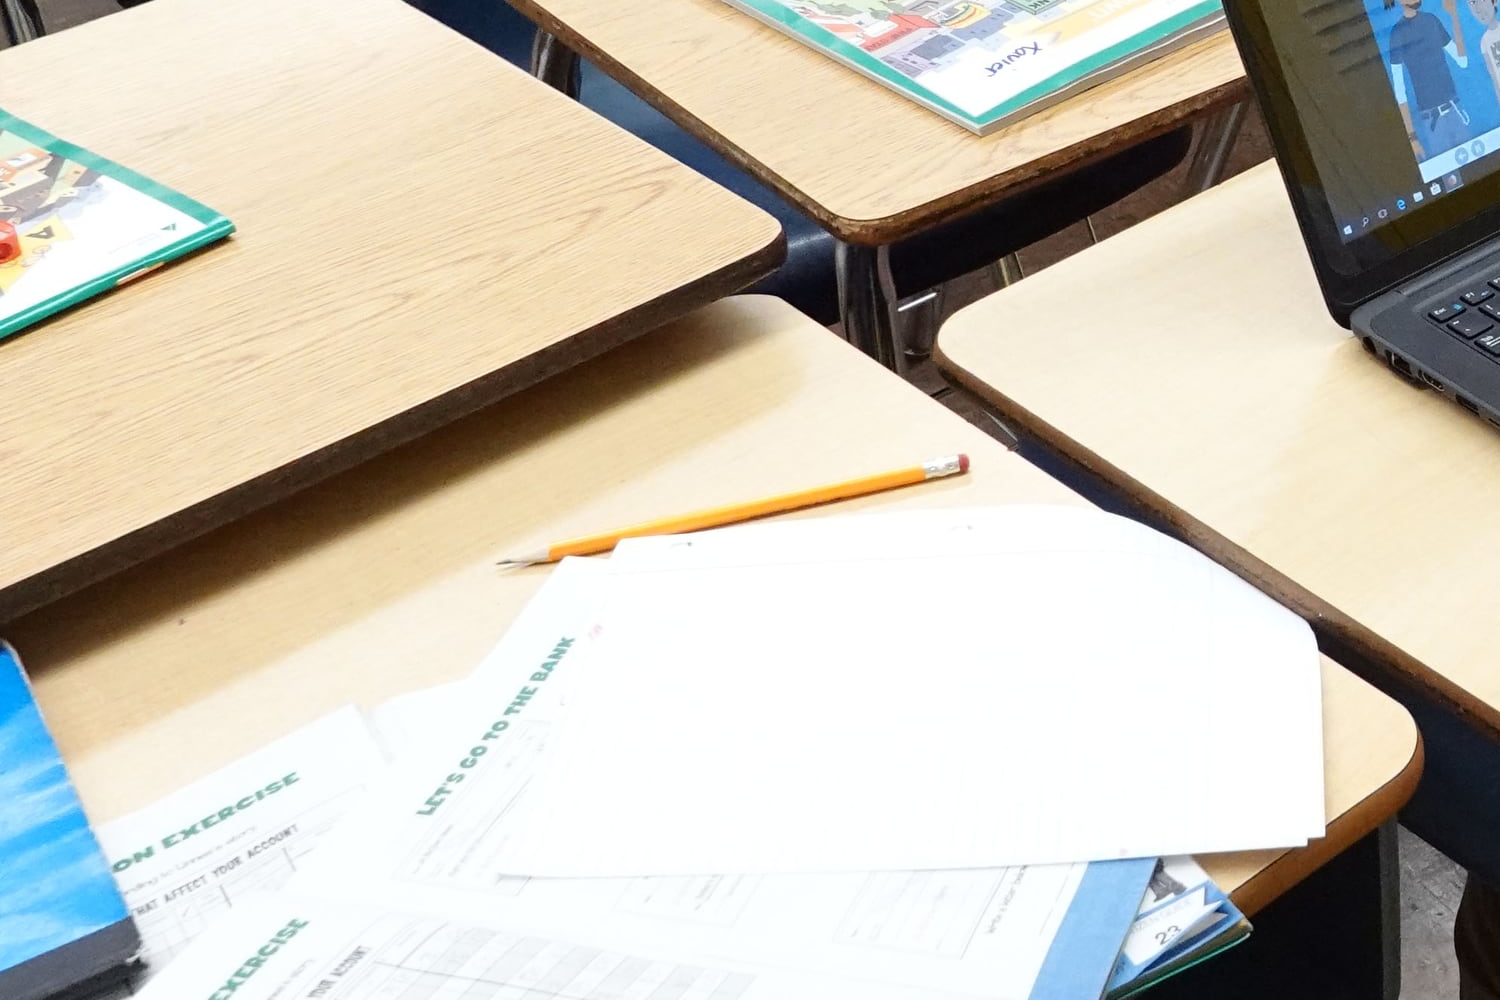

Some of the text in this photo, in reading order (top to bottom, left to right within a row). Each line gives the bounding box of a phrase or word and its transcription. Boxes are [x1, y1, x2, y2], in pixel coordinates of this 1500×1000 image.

[983, 39, 1044, 79] Xavier
[414, 771, 468, 817] LET'S
[458, 743, 490, 770] GO
[480, 719, 511, 742] TO
[502, 684, 540, 717] THE
[528, 635, 578, 683] BANK
[160, 770, 301, 849] EXERCISE
[163, 875, 209, 903] AFFECT
[211, 855, 244, 879] YOUR
[246, 822, 300, 859] ACCOUNT
[207, 917, 311, 1000] EXERCISE
